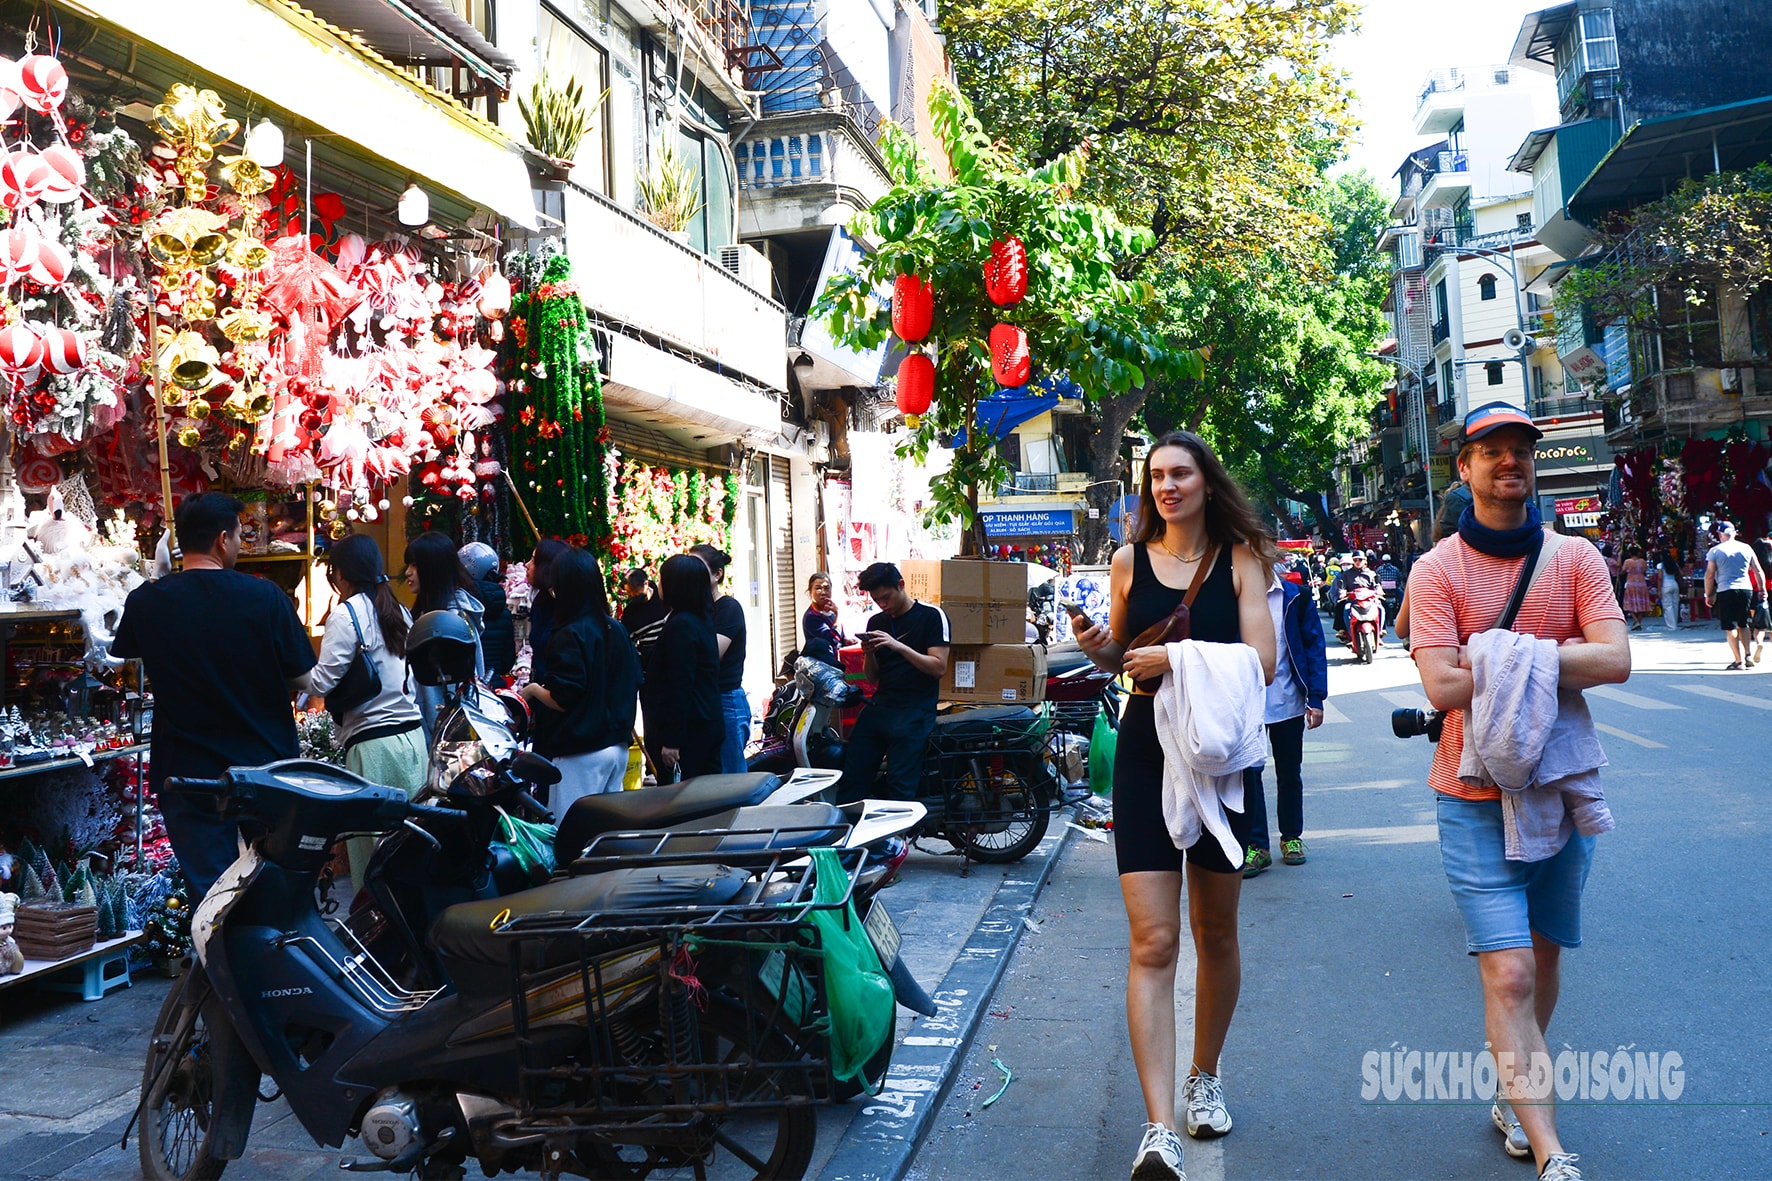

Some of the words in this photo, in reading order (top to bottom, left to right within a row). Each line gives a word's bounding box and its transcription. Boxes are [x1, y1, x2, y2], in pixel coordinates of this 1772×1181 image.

[996, 514, 1025, 522] THANH
[1026, 511, 1050, 521] HÀNG
[262, 986, 313, 998] HONDA
